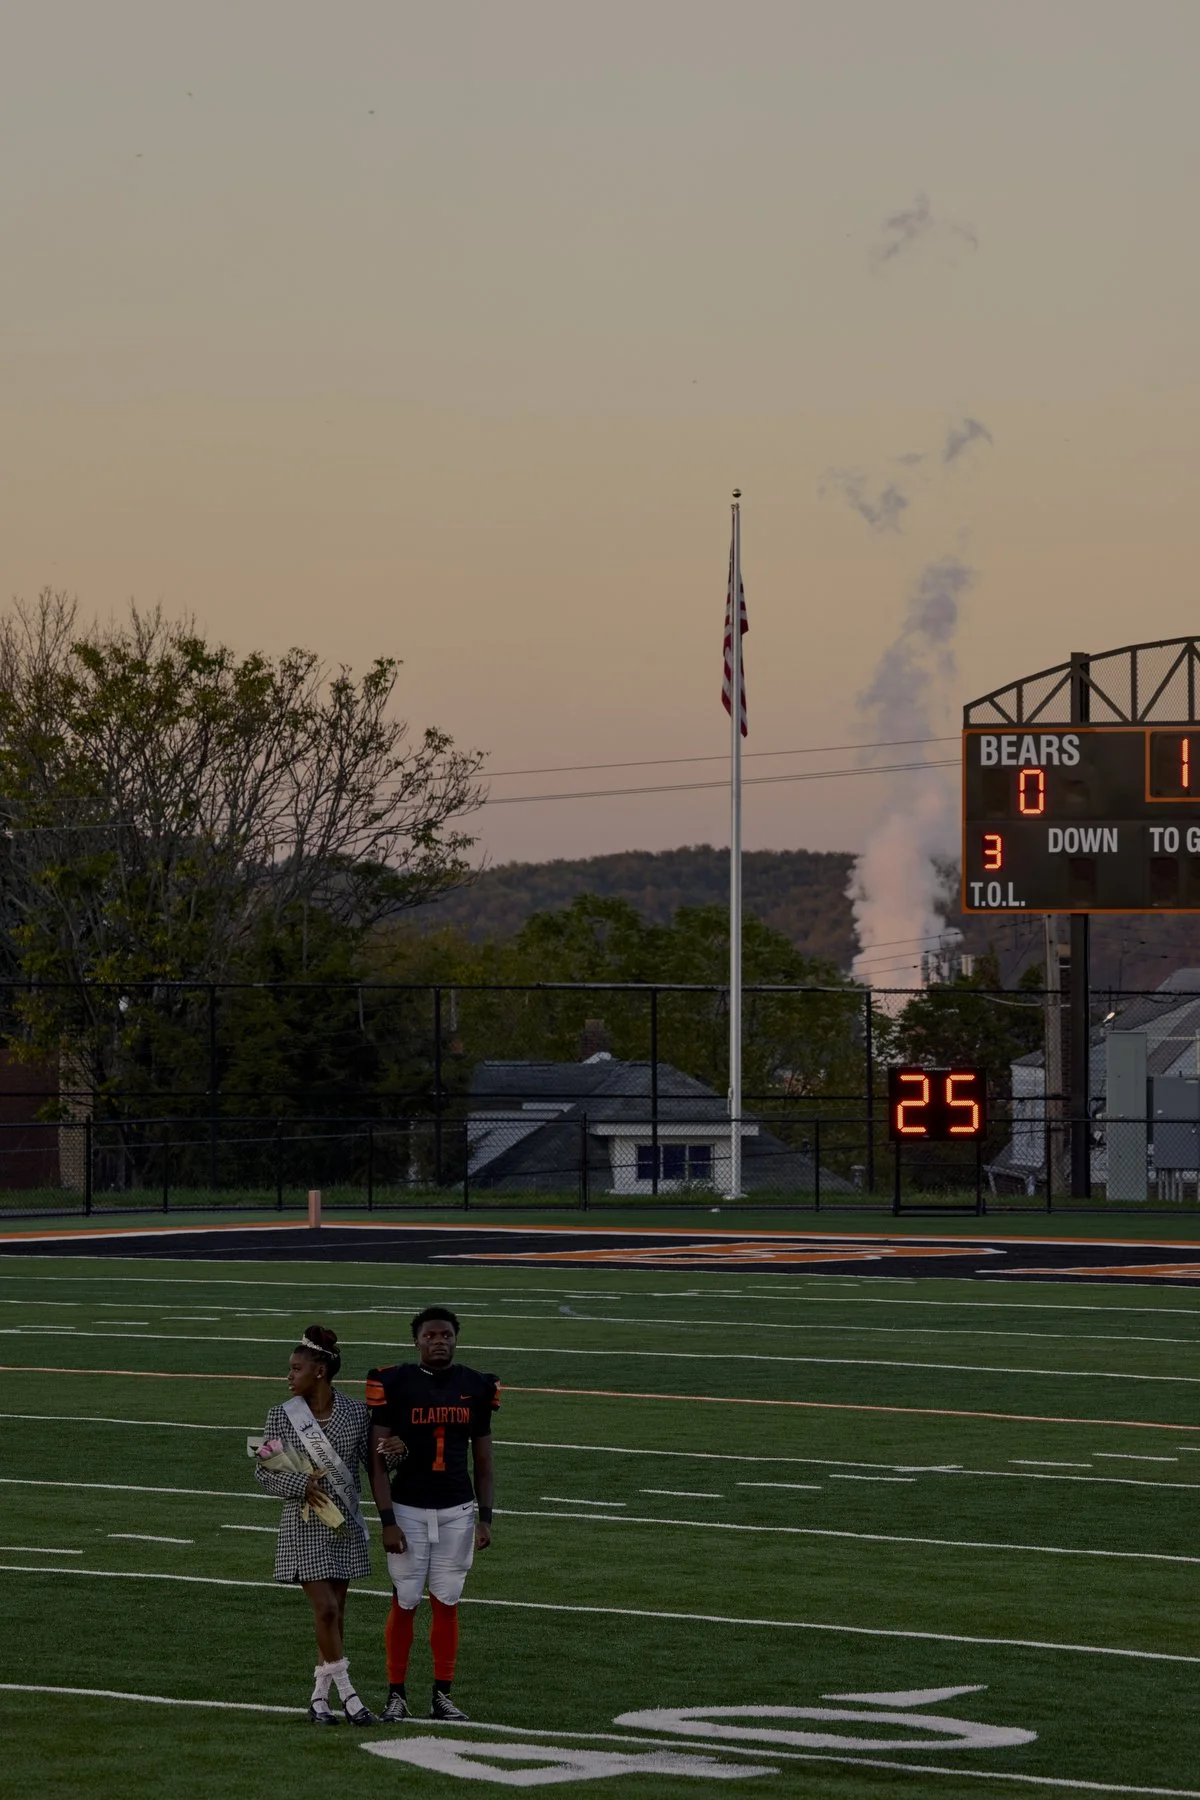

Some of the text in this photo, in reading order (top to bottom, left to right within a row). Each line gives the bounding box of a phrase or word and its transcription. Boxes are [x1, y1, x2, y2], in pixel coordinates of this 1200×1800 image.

[980, 734, 1080, 766] BEARS
[1019, 768, 1045, 814] 0
[983, 834, 1002, 870] 3
[1048, 827, 1119, 853] DOWN
[1149, 826, 1180, 853] TO
[970, 881, 1026, 908] T.O.L.
[896, 1074, 979, 1133] 25
[411, 1406, 471, 1425] CLAIRTON
[305, 1431, 346, 1486] Homecoming
[431, 1425, 447, 1472] 1
